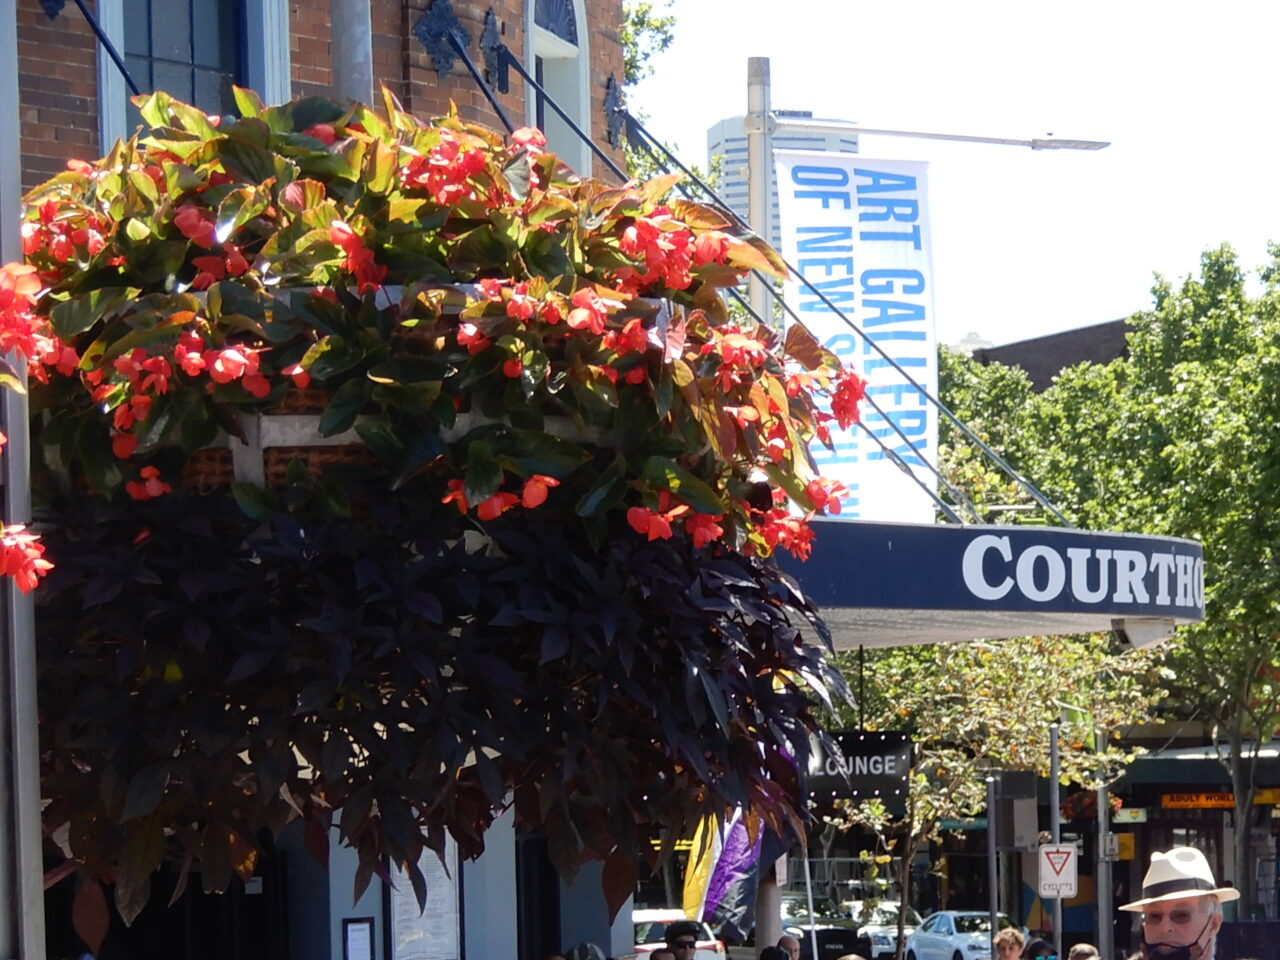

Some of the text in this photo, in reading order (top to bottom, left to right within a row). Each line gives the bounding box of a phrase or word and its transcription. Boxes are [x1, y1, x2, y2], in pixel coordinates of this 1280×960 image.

[791, 165, 852, 210] OF
[796, 226, 855, 313] NEW
[853, 168, 927, 468] ART GALLERY
